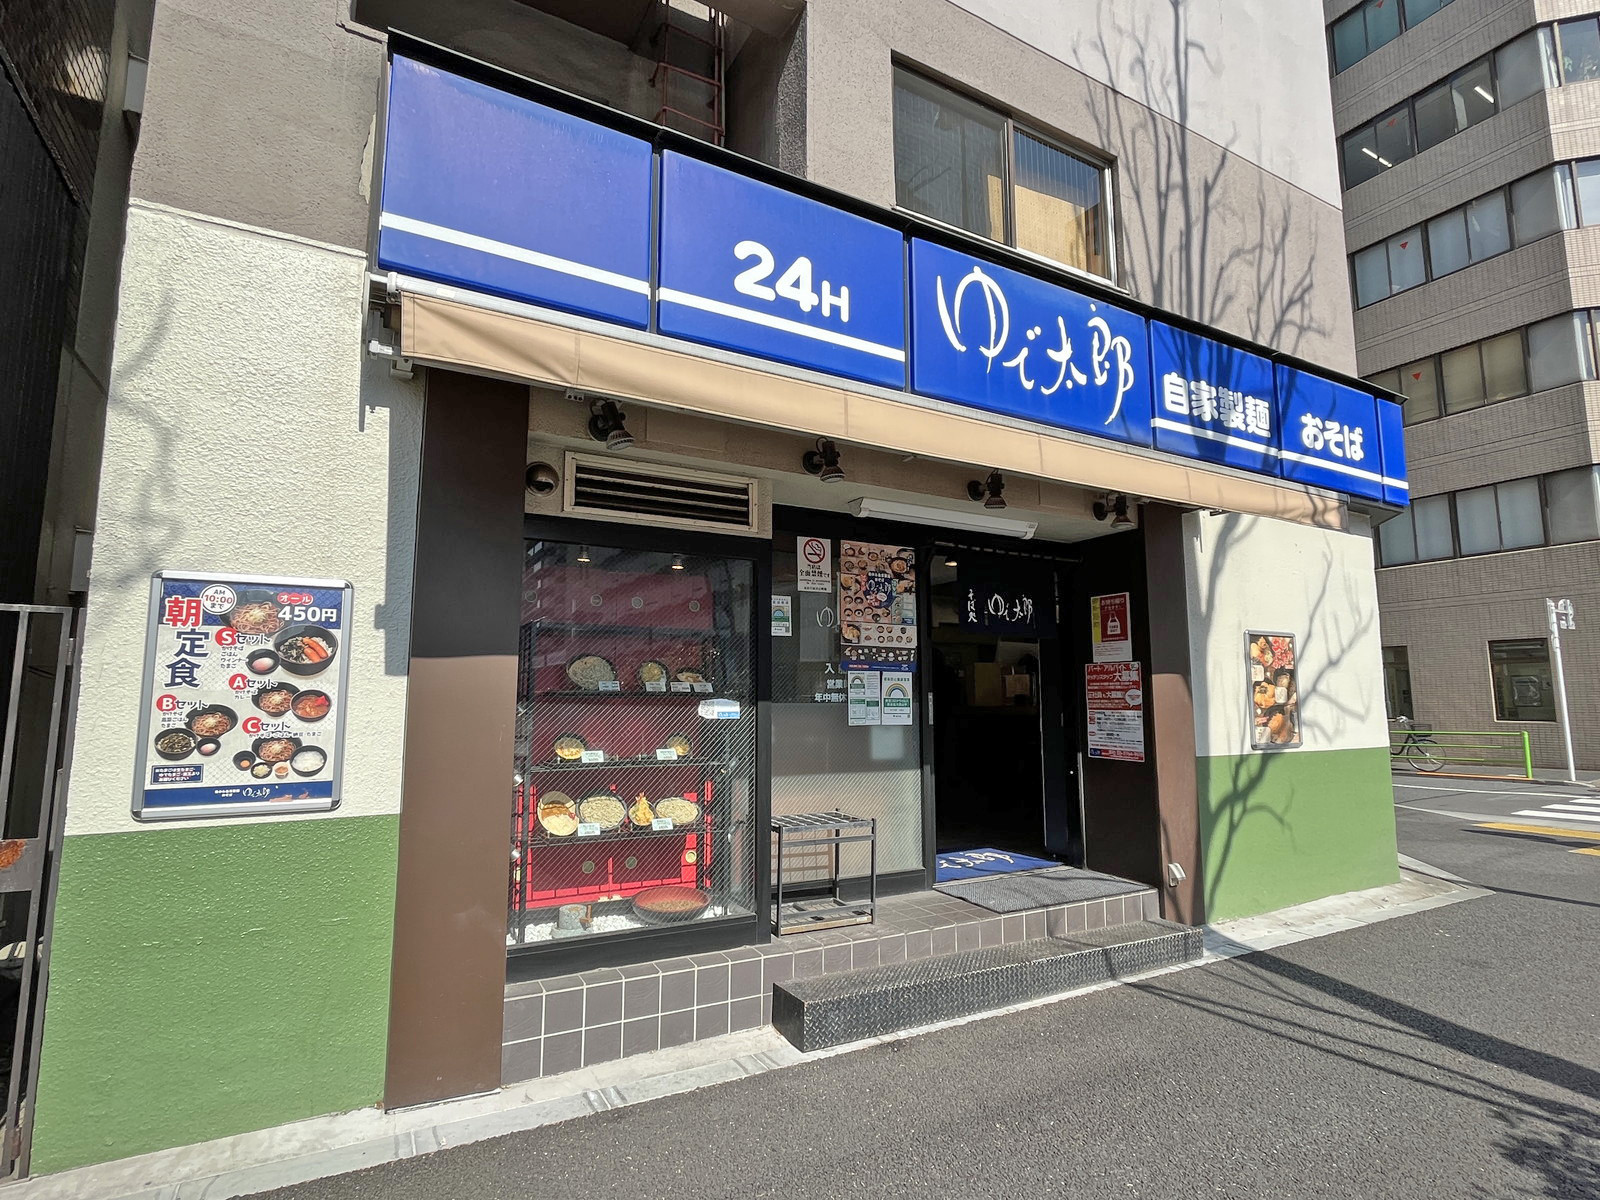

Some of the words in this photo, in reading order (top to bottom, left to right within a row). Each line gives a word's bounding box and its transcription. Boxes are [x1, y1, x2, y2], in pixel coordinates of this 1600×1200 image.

[733, 240, 849, 323] 24H
[936, 265, 1135, 425] ゆで太郎
[1162, 371, 1271, 438] 自家製麺
[1300, 412, 1365, 462] おそば
[204, 594, 234, 604] 10:00
[280, 594, 311, 603] オール
[277, 605, 338, 623] 450円
[987, 592, 1033, 625] ゆで太郎
[164, 596, 211, 688] 朝定食
[221, 631, 271, 646] Sセット
[232, 676, 278, 689] Aセット
[162, 697, 209, 710] Bセット
[247, 719, 291, 731] Cセット
